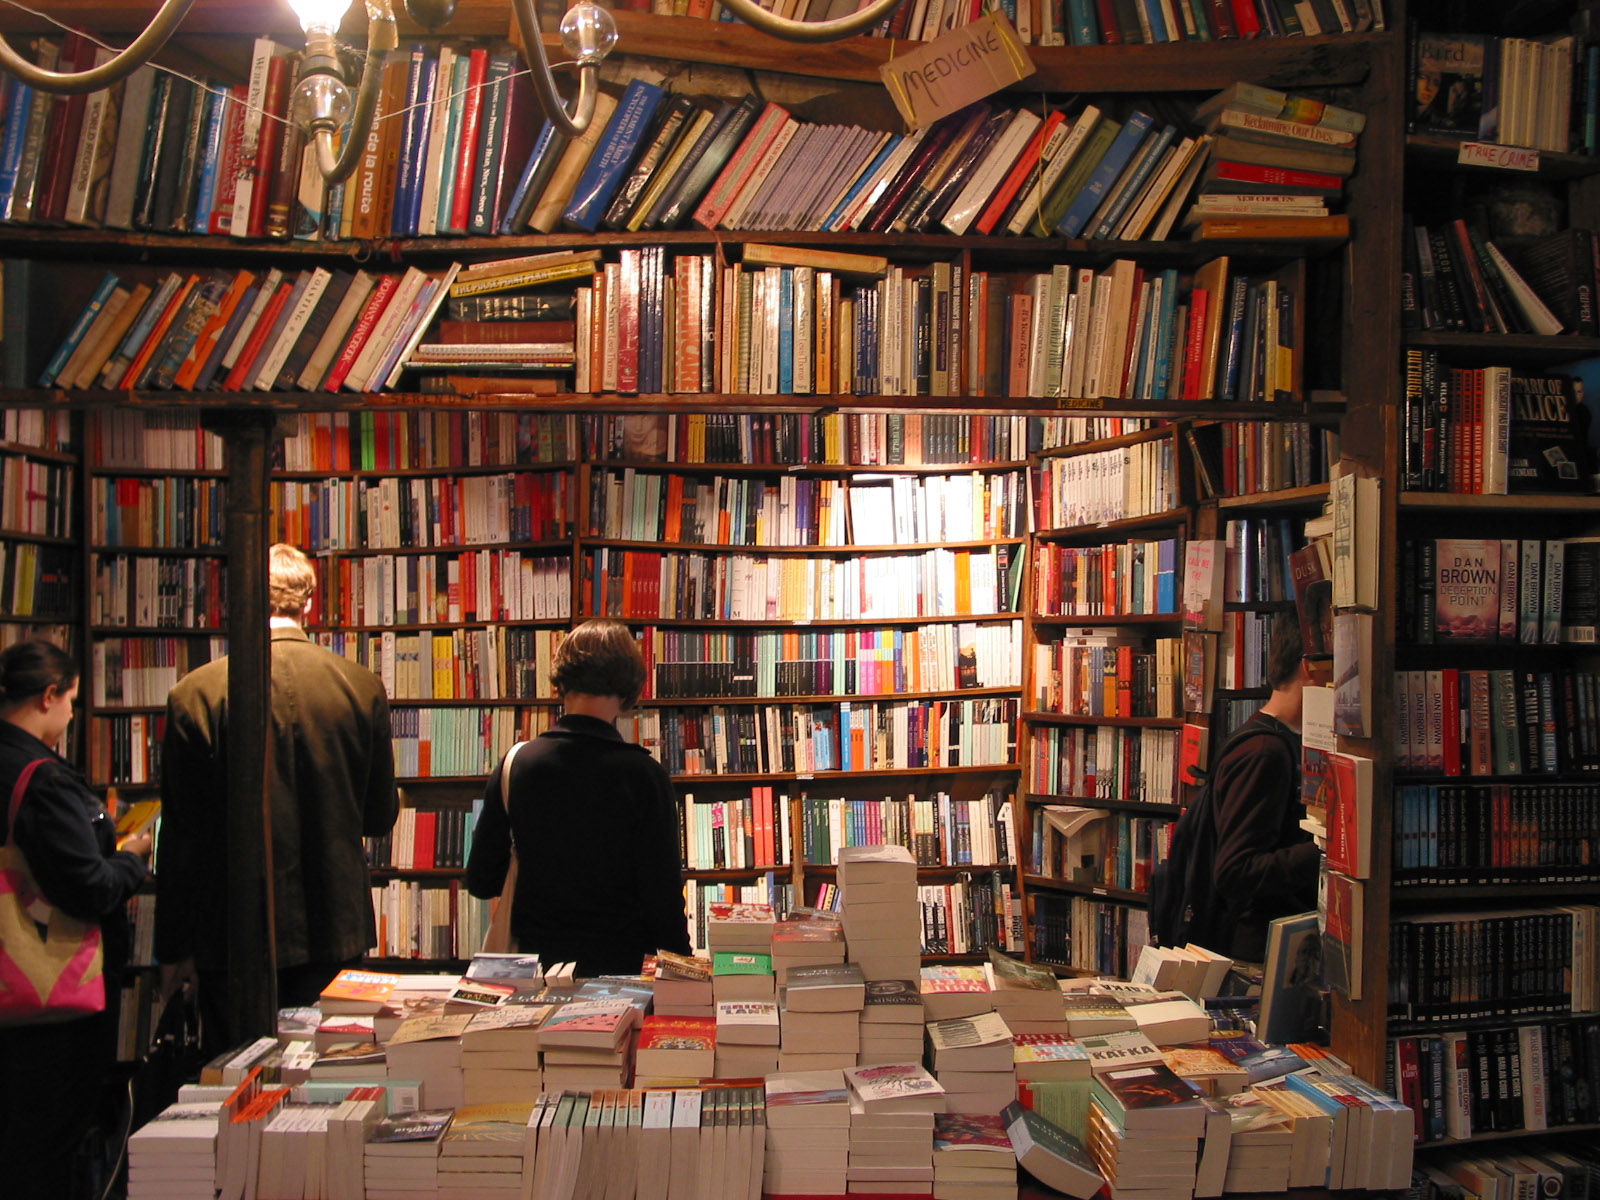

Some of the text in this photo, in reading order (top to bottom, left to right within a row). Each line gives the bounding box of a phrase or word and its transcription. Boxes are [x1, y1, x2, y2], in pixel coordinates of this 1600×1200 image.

[903, 31, 999, 108] MEDICINE
[1292, 124, 1308, 136] Our
[74, 100, 103, 193] WORLD REGIONS
[1464, 144, 1537, 169] TRUE CRIME
[1407, 350, 1422, 398] OUTRAGE
[1440, 382, 1448, 404] KILO
[1547, 379, 1562, 395] OF
[1060, 400, 1100, 408] MEDICINE
[1454, 557, 1484, 568] DAN
[1440, 569, 1496, 584] BROWN
[1504, 561, 1517, 613] DAN BROWN
[1528, 561, 1538, 613] DAN BROWN
[1552, 561, 1562, 613] DAN BROWN
[1440, 586, 1497, 596] DECEPTION
[1450, 596, 1486, 606] POINT
[1415, 692, 1425, 745] DAN BROWN
[1432, 692, 1443, 745] DAN BROWN
[1092, 1045, 1154, 1060] KAFKA
